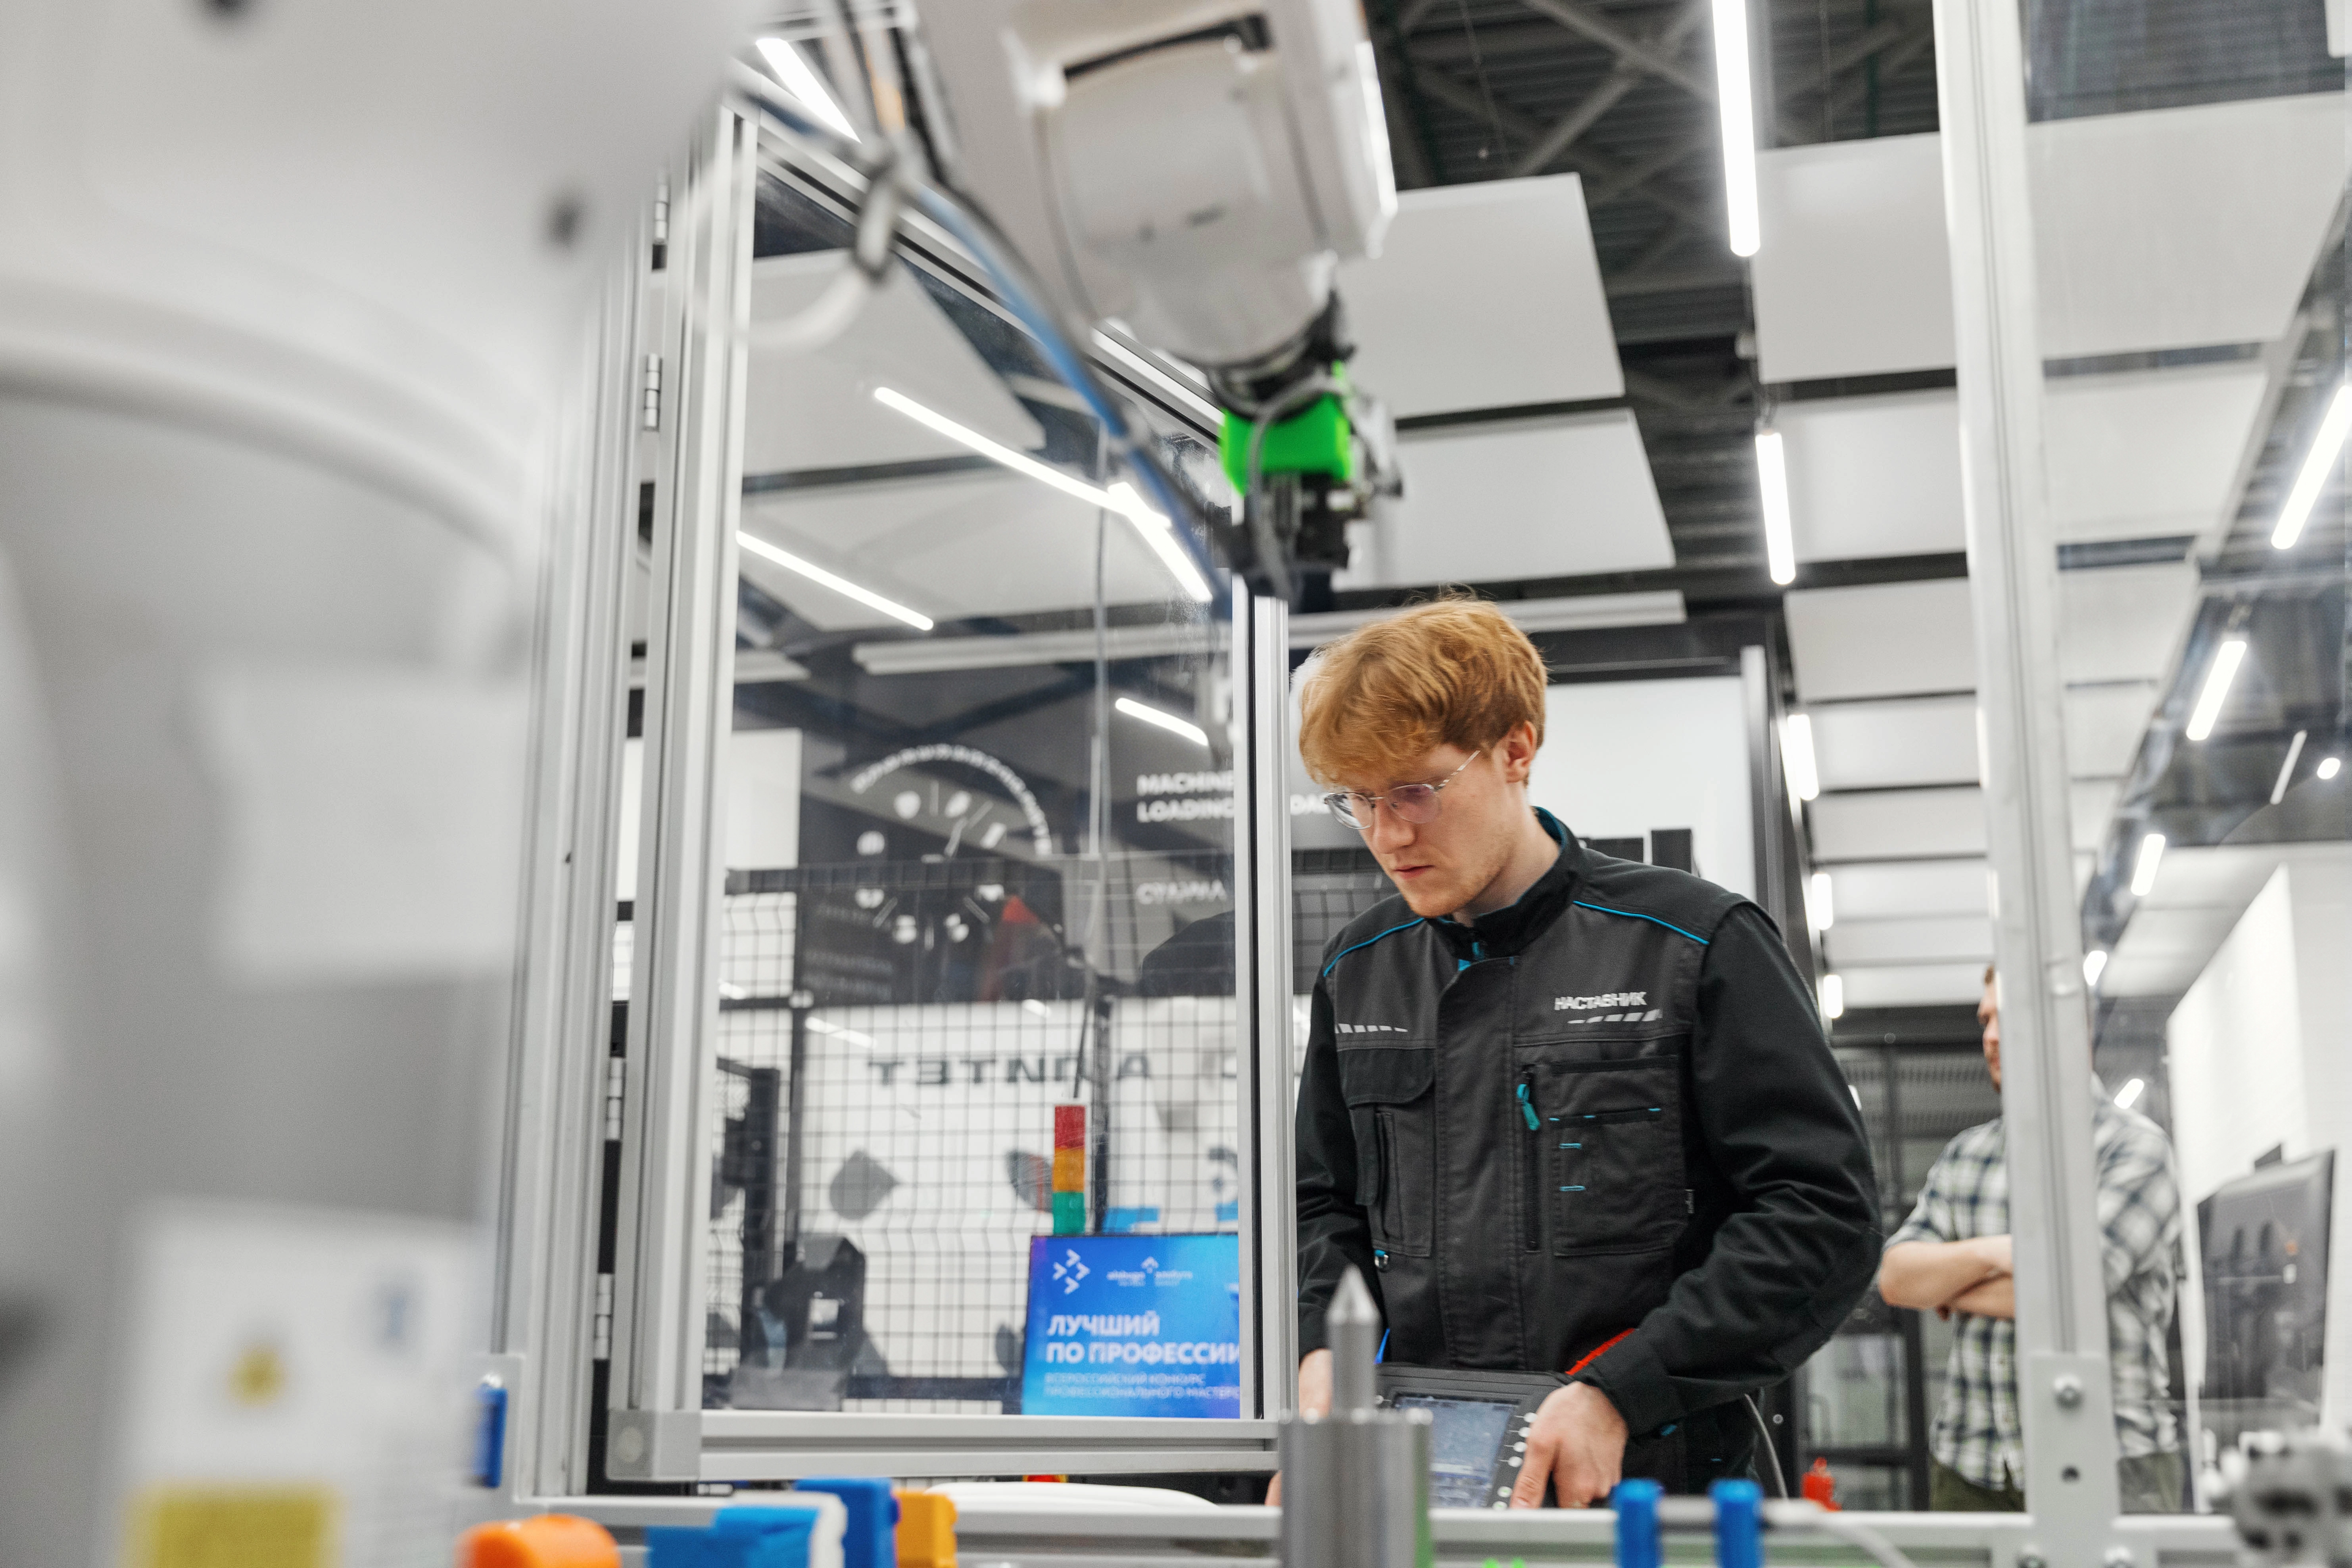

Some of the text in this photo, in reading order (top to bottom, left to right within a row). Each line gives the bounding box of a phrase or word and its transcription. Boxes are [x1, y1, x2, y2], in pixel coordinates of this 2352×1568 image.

[1554, 991, 1647, 1011] НАСТАВНИК
[1047, 1310, 1160, 1336] ЛУЧШИЙ
[1046, 1342, 1085, 1363] ПО
